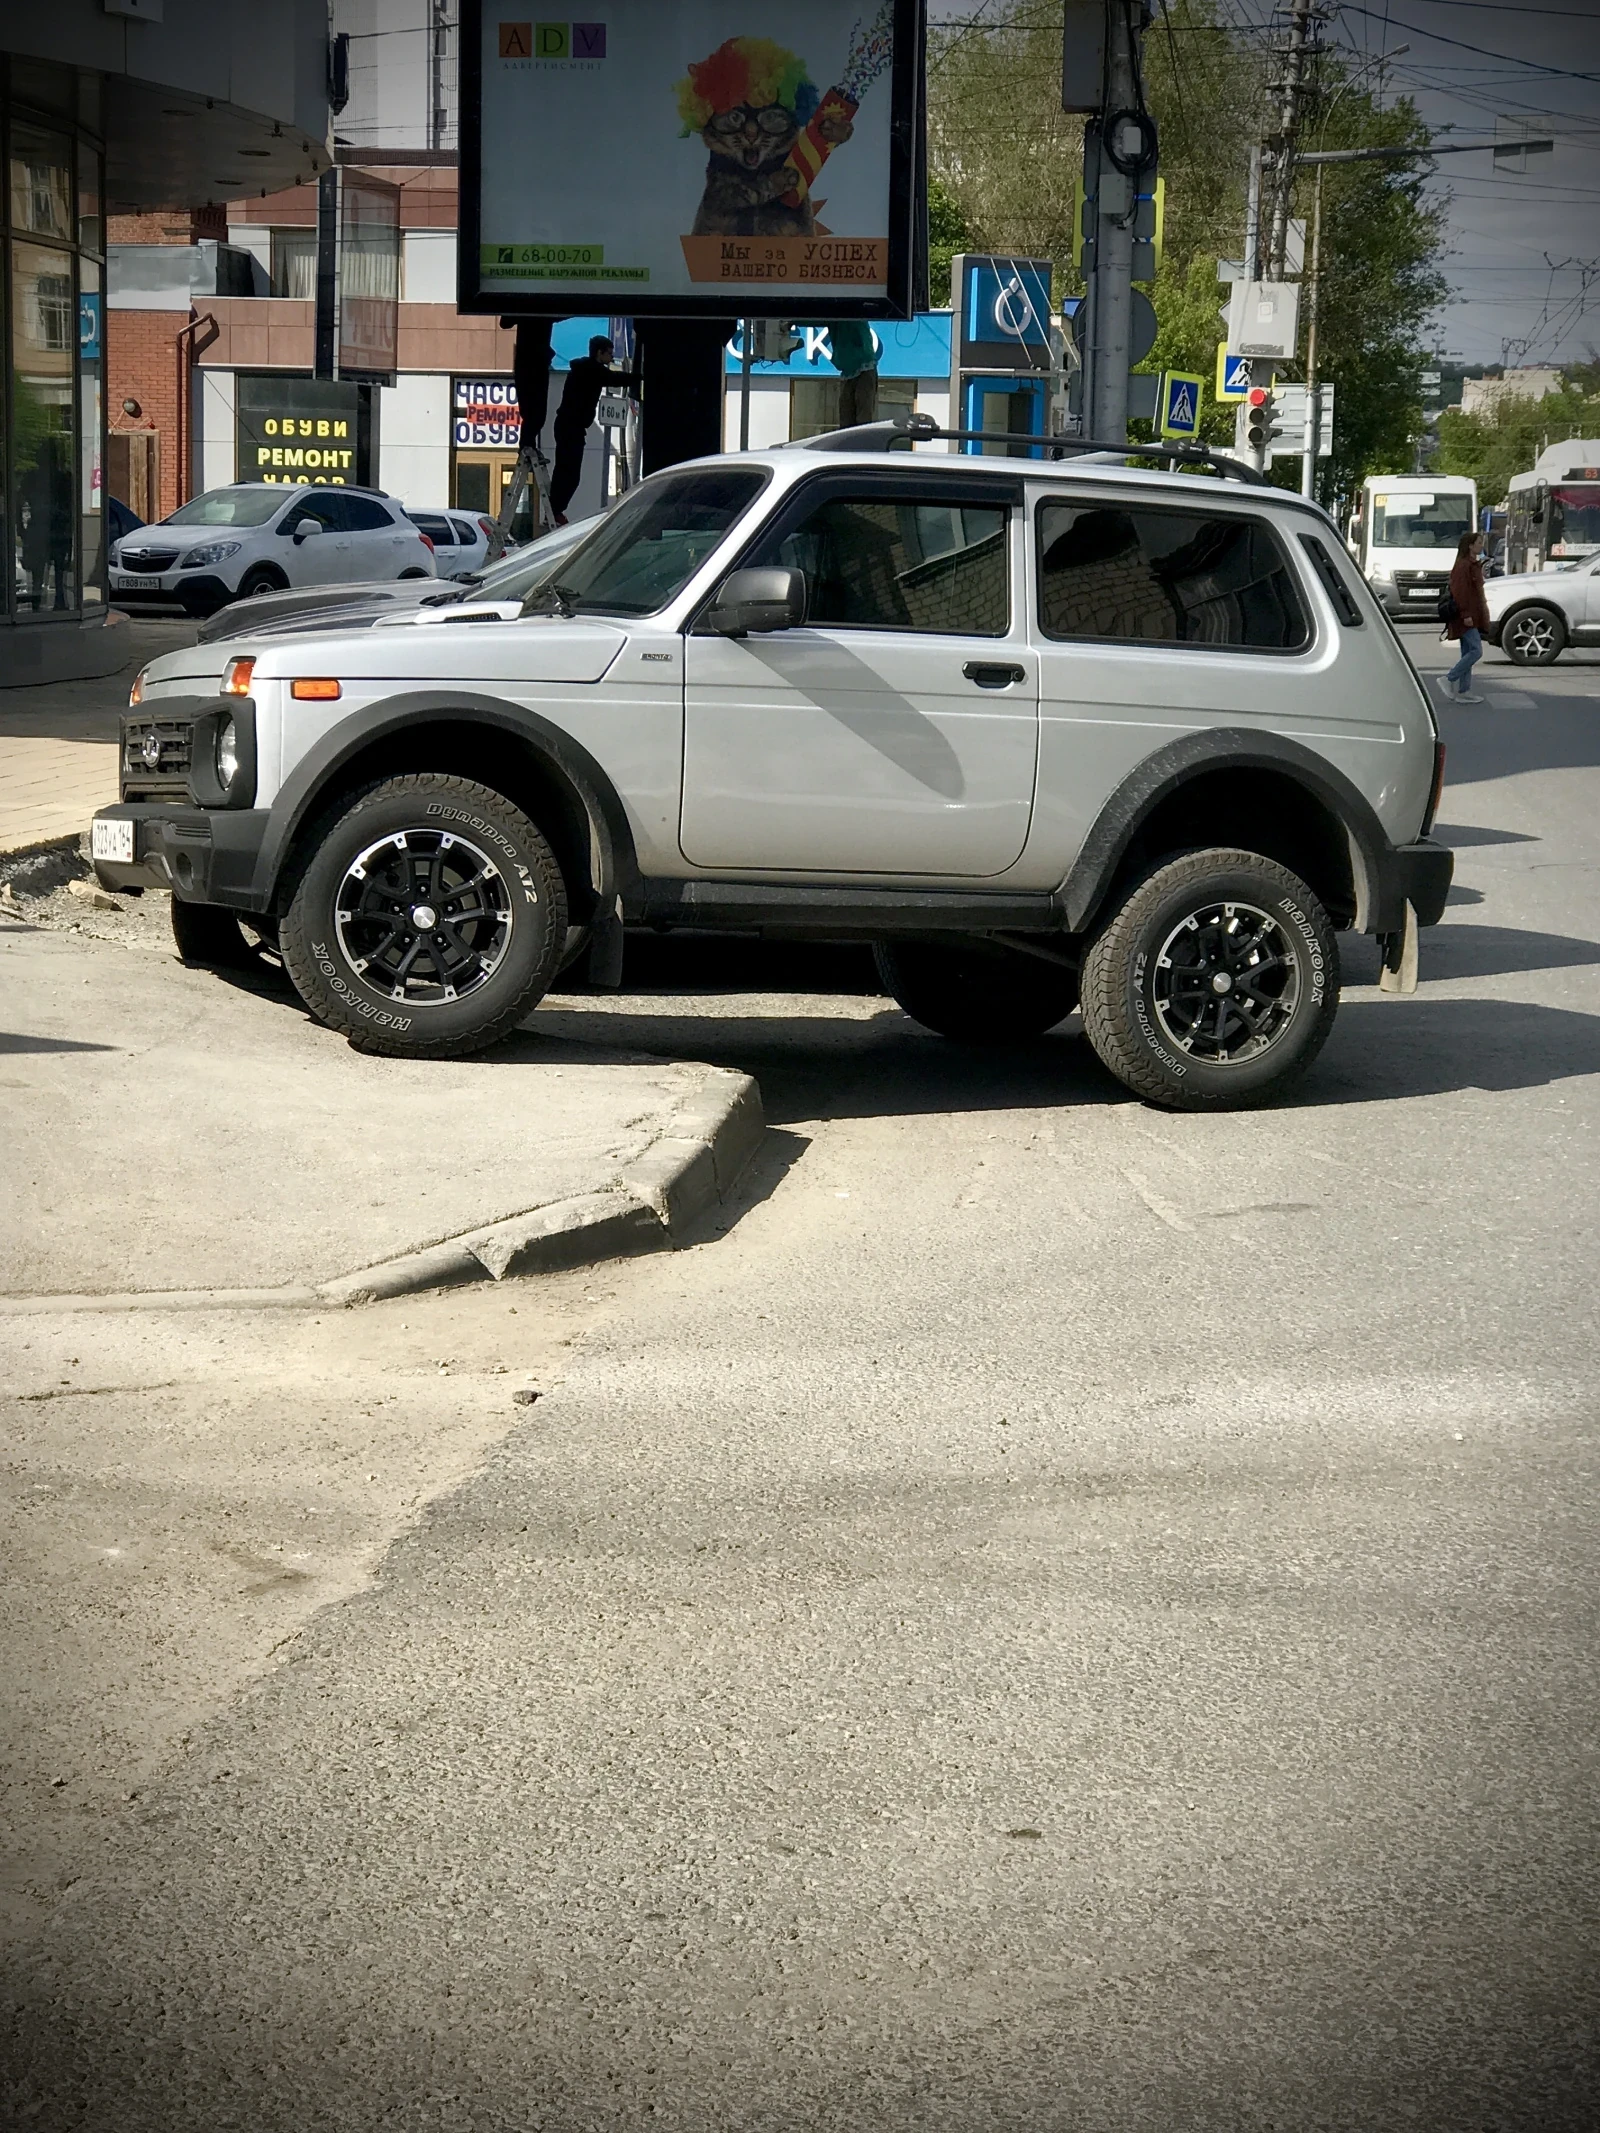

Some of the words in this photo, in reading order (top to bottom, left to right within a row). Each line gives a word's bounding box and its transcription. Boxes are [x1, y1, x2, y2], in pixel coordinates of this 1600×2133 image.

[504, 27, 600, 54] ADV
[521, 249, 592, 263] 68-00-70
[720, 242, 750, 260] Мы
[764, 249, 786, 260] за
[804, 243, 878, 261] УСПЕХ
[489, 268, 545, 277] РАЗМЕЩЕНИЕ
[549, 268, 597, 278] НАРУЖНОЙ
[601, 269, 644, 278] РЕКЛАМЫ
[720, 263, 788, 278] ВАШЕГО
[799, 264, 877, 279] БИЗНЕСА
[606, 406, 615, 418] 60
[264, 418, 347, 437] ОБУВИ
[257, 447, 353, 468] РЕМОНТ
[513, 862, 538, 904] AT2
[1132, 951, 1148, 994] AT2
